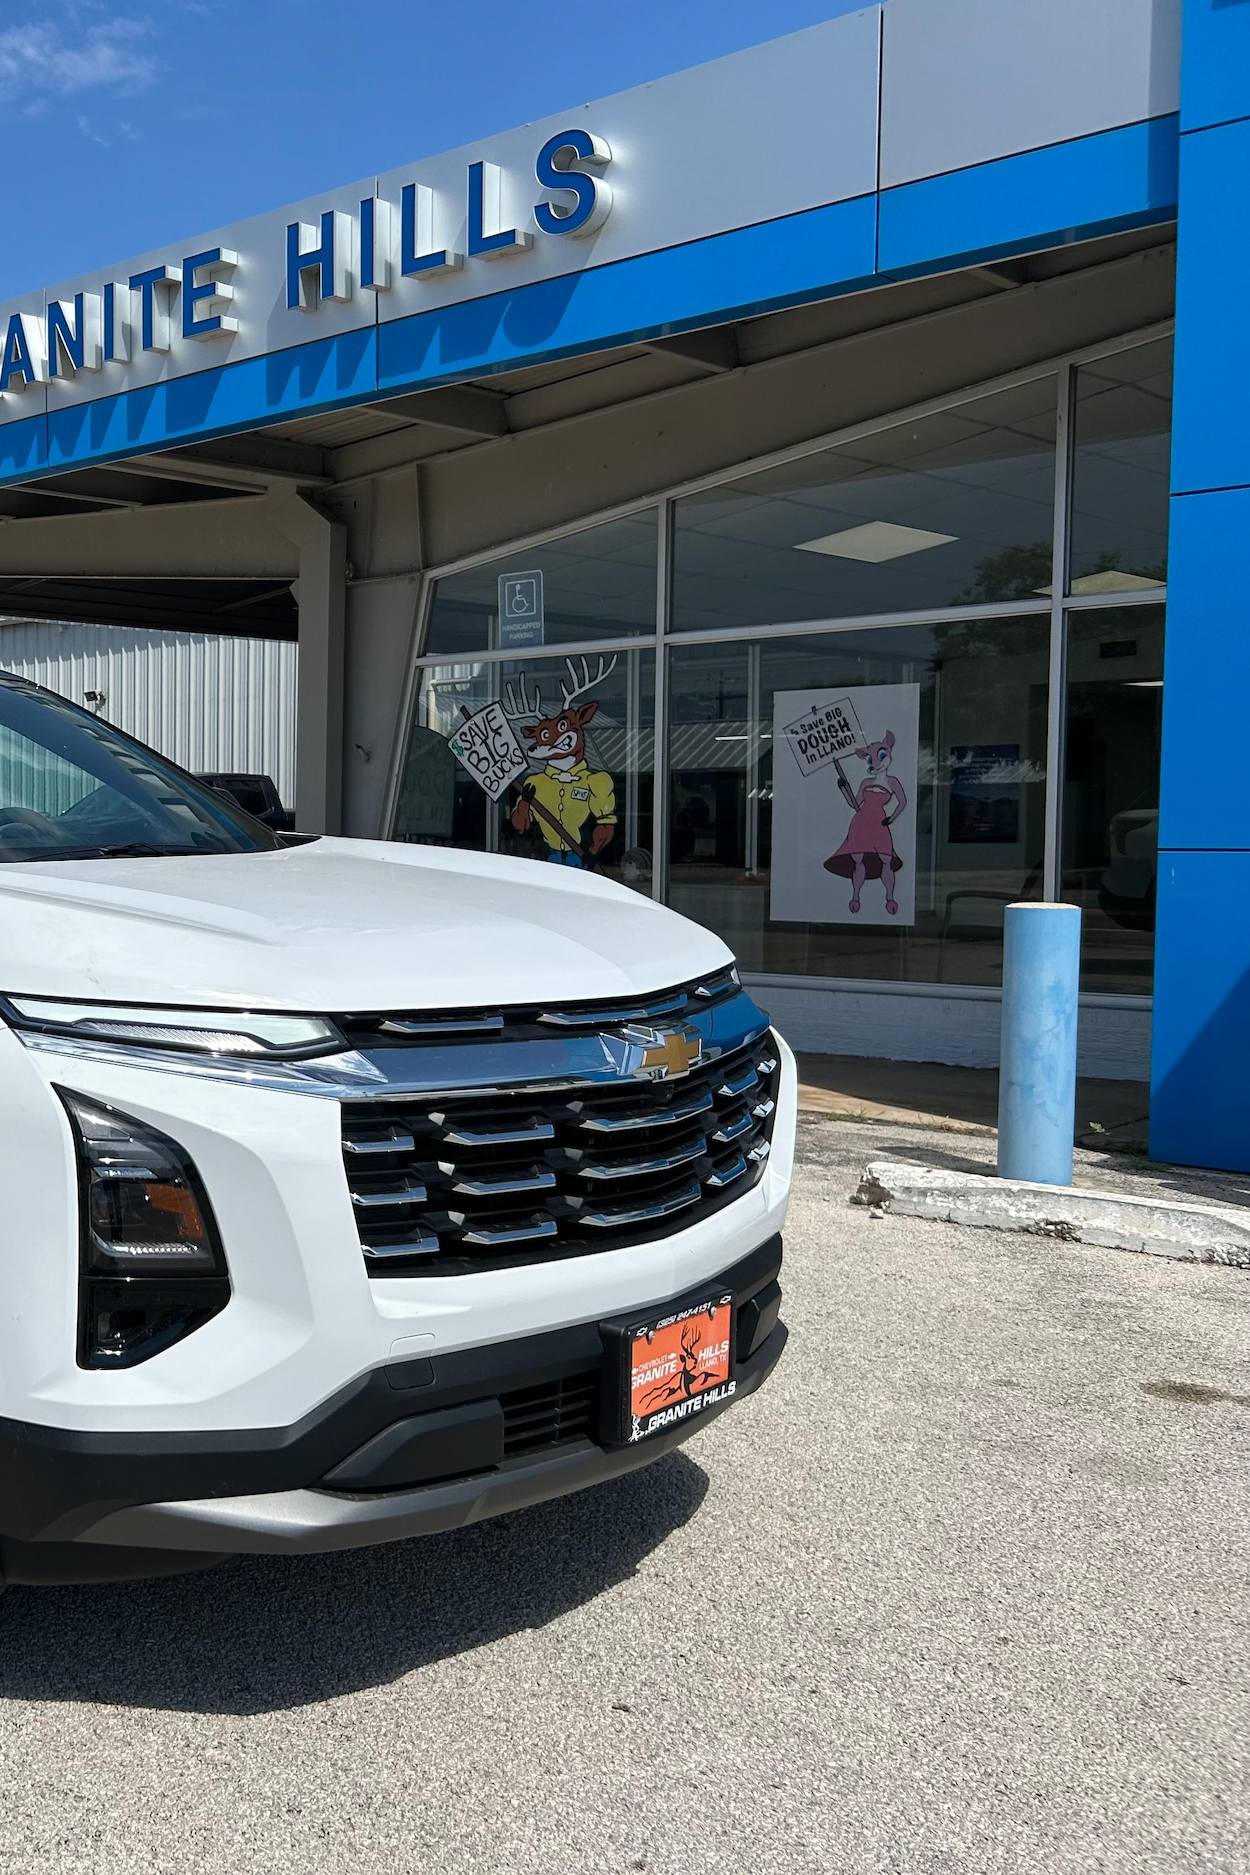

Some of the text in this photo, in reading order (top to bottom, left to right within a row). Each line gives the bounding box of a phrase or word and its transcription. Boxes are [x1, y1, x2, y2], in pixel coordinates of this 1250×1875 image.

[287, 128, 612, 312] HILLS
[501, 621, 541, 632] HANDICAPPED
[509, 631, 534, 640] PARKING
[459, 708, 503, 751] SAVE
[800, 707, 842, 734] Save BIG
[797, 717, 852, 755] DOUGH
[817, 733, 856, 758] LLANO!
[467, 731, 509, 774] BIG
[482, 748, 524, 793] BUCKS
[638, 1354, 668, 1371] CHEVROLET
[698, 1340, 729, 1363] HILLS
[631, 1360, 678, 1390] GRANITE
[648, 1381, 737, 1431] GRANITE HILLS
